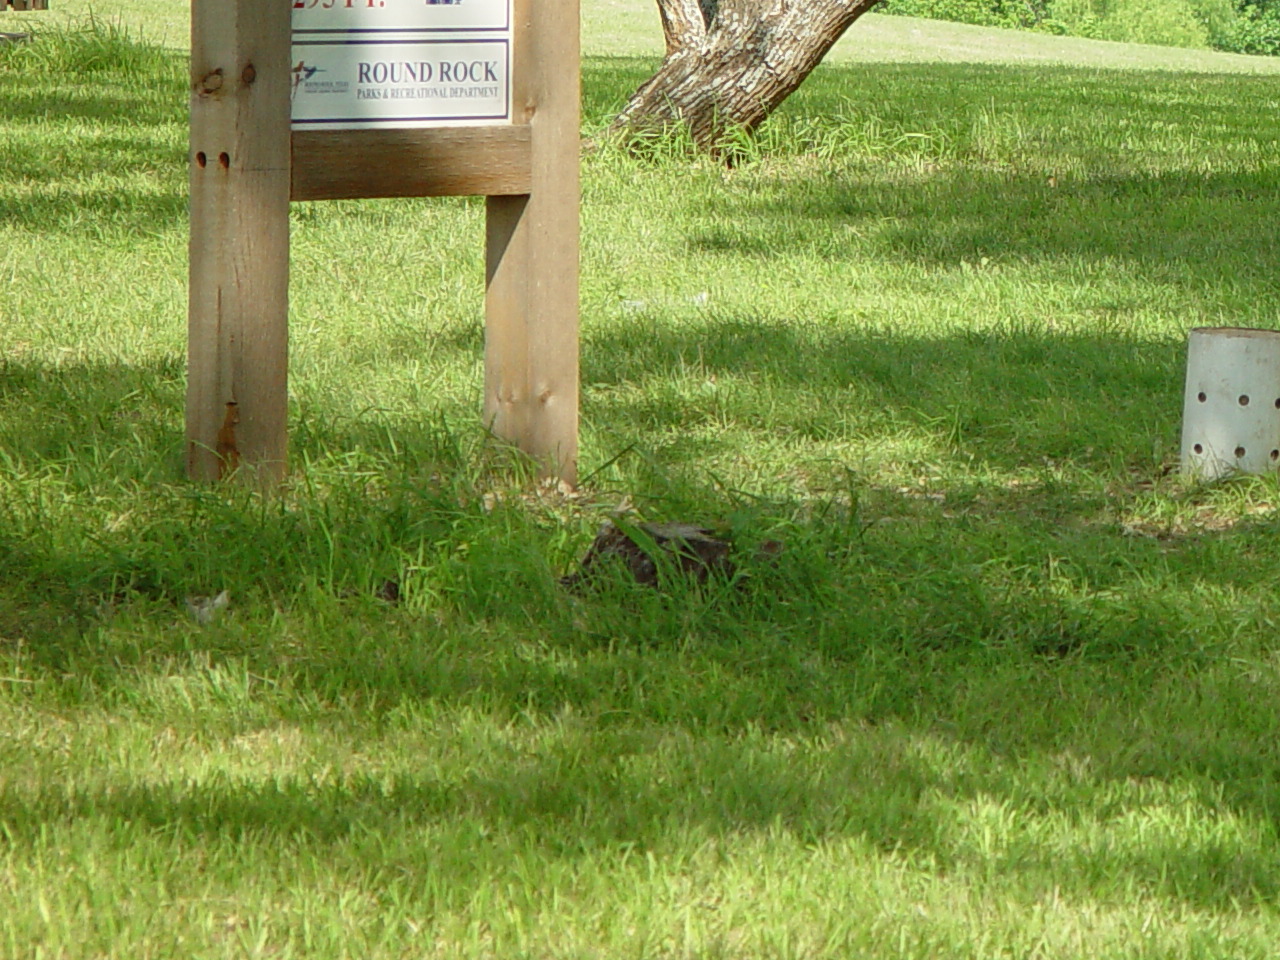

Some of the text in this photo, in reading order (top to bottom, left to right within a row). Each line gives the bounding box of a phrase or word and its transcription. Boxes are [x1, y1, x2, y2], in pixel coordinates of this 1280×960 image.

[358, 60, 498, 84] ROUND ROCK
[357, 88, 382, 100] PARKS
[382, 88, 389, 99] &
[390, 87, 447, 99] RECREATIONAL
[449, 86, 498, 98] DEPARTMENT
